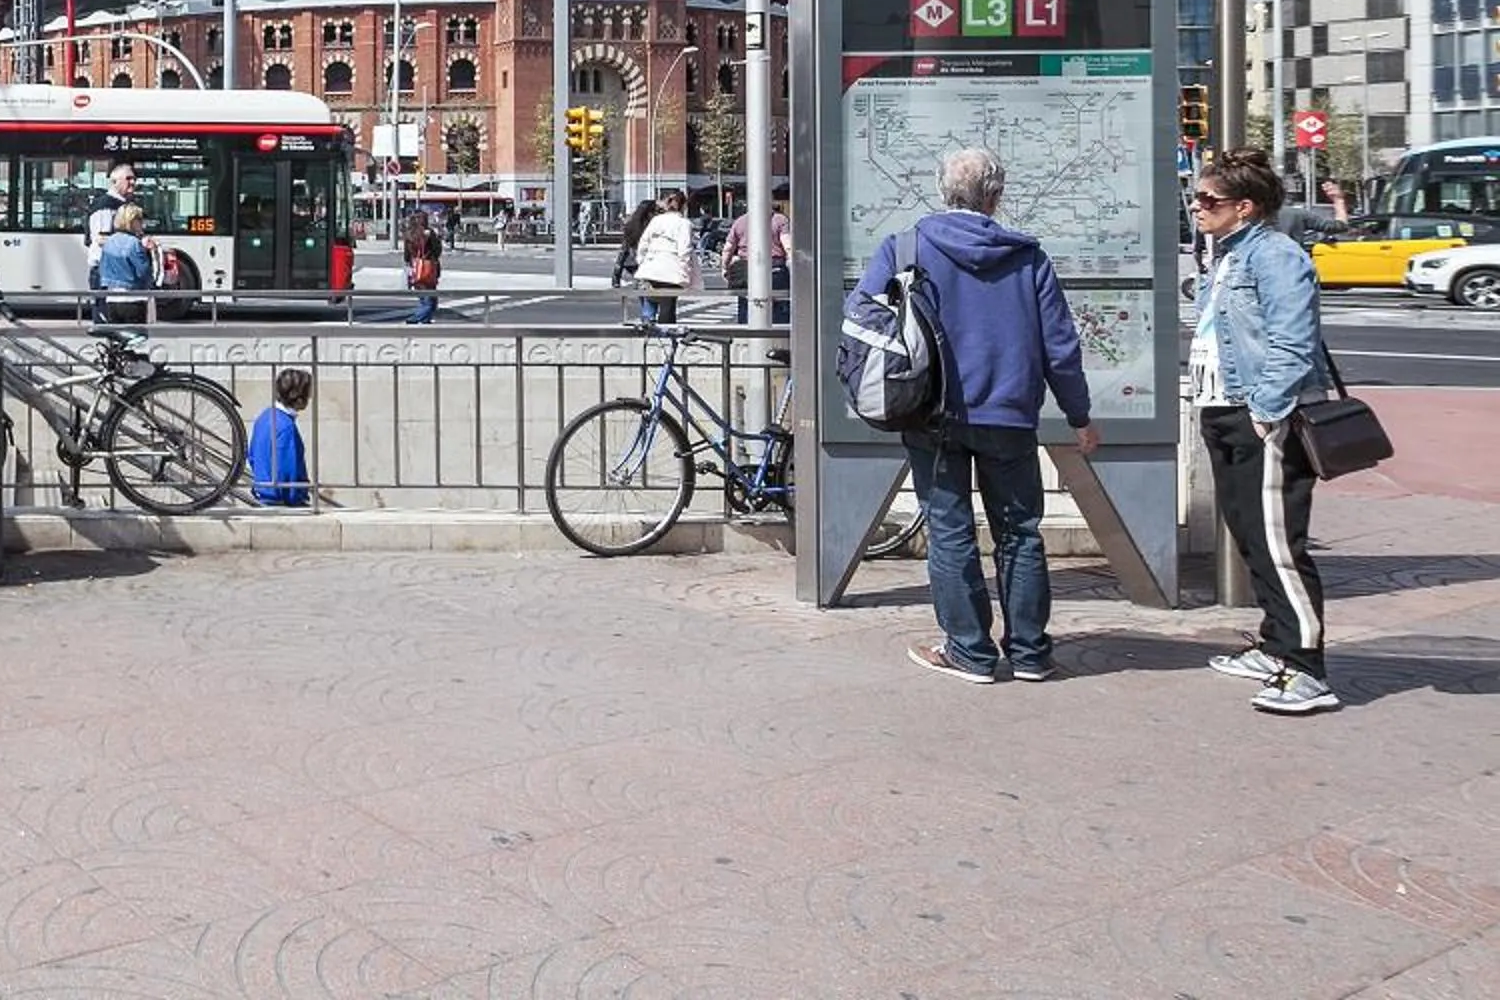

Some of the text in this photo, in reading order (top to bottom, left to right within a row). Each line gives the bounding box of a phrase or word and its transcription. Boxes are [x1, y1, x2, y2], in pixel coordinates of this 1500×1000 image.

[925, 5, 943, 20] M
[190, 217, 215, 232] 165
[339, 337, 471, 364] metro
